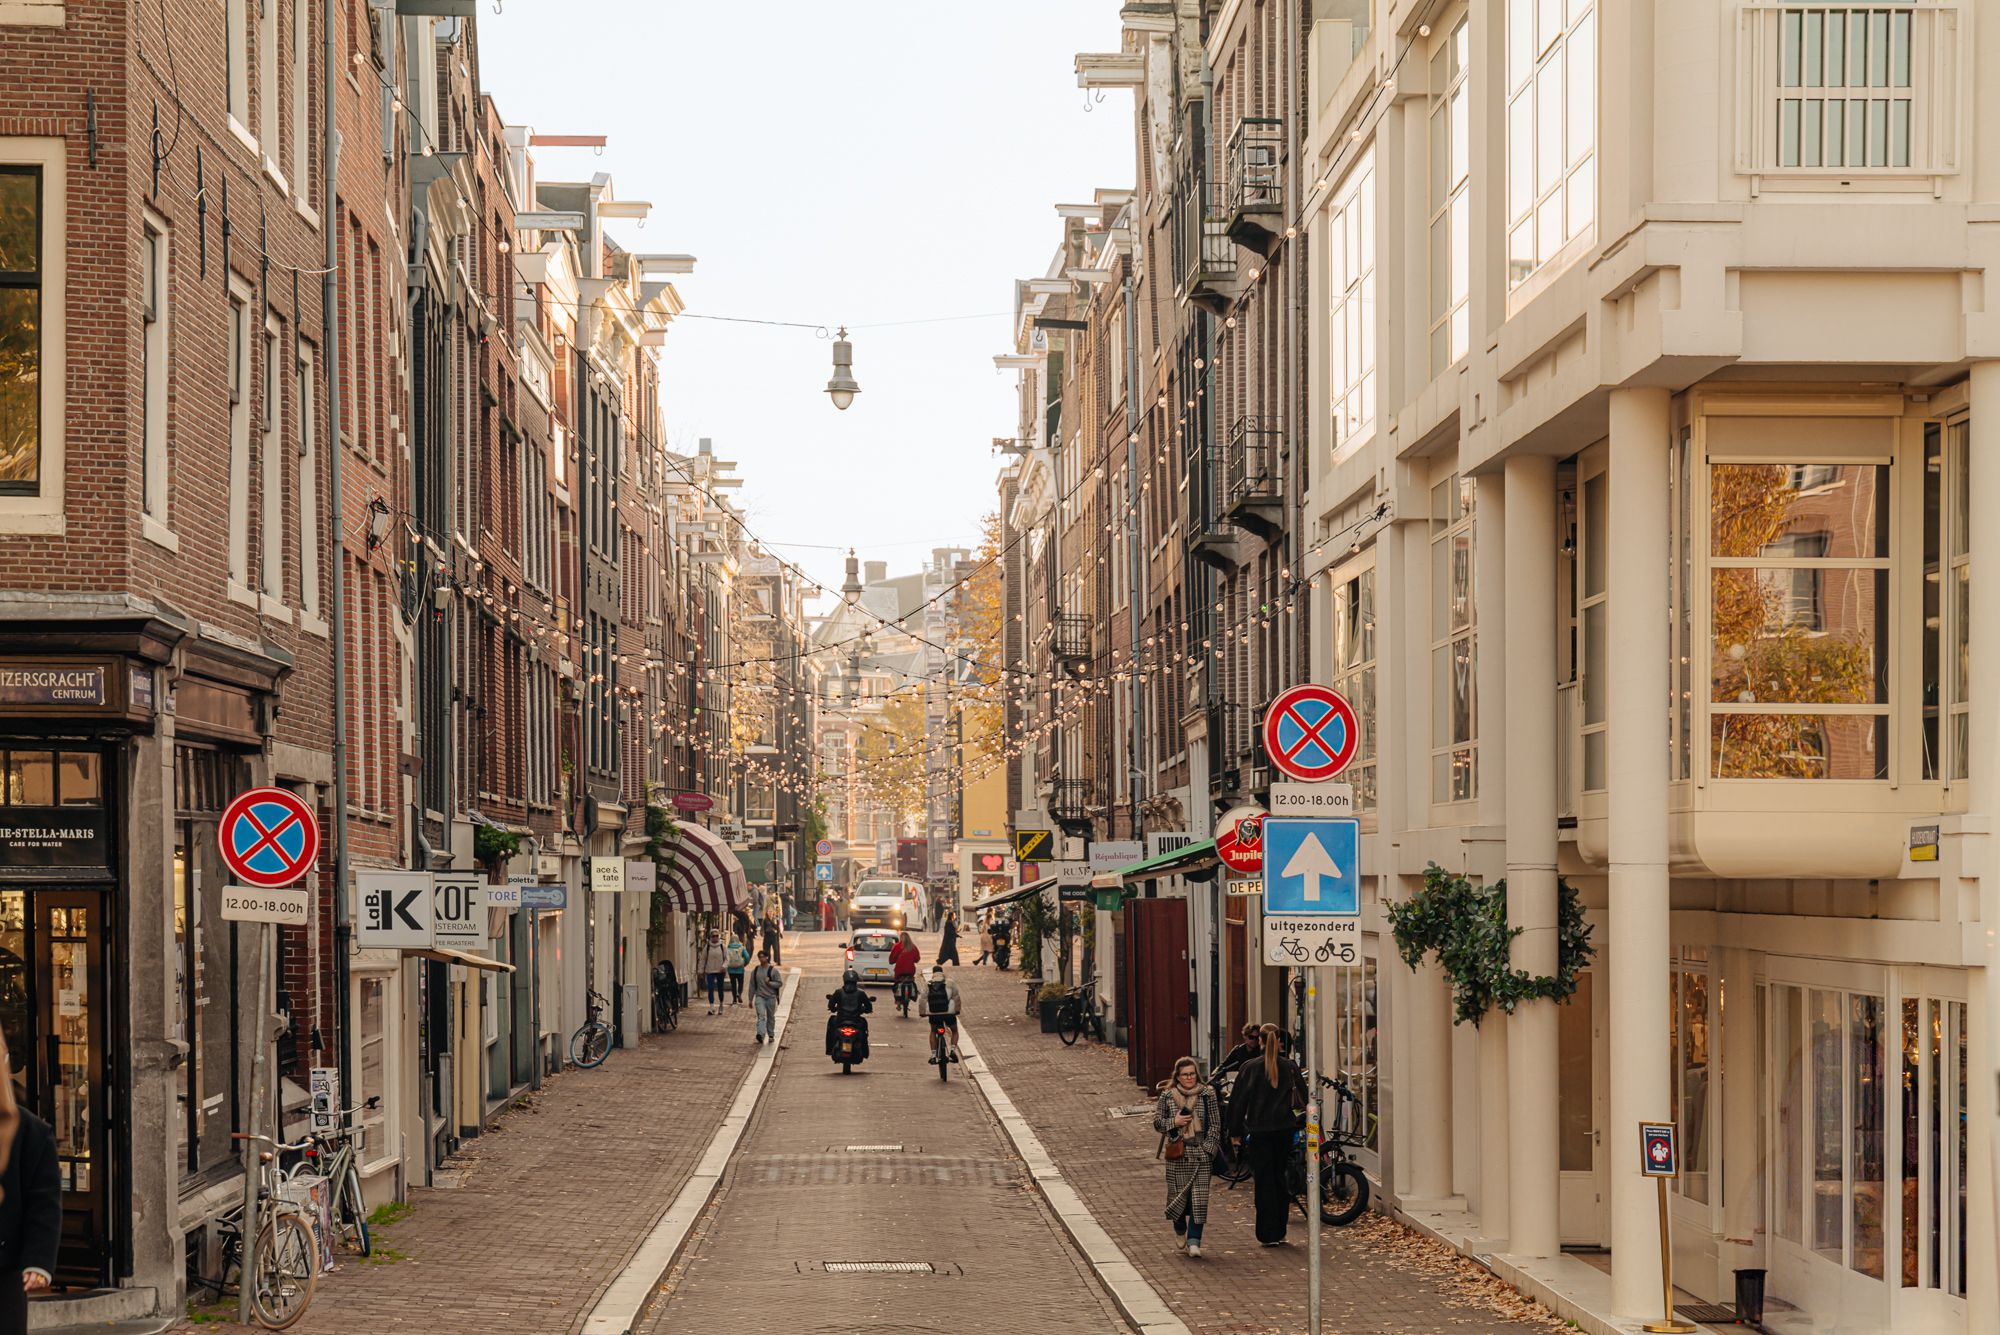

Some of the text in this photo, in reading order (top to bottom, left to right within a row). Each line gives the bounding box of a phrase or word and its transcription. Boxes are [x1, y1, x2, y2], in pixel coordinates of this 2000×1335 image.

[1, 672, 96, 687] IZERSGRACHT
[52, 689, 96, 699] CENTRUM
[1275, 794, 1349, 806] 12.00-18.00h
[0, 828, 95, 839] IE-STELLA-MARIS
[1095, 852, 1138, 861] République
[613, 866, 618, 874] &
[508, 876, 535, 884] polette
[602, 874, 619, 882] tate
[1230, 881, 1262, 894] DE PE
[488, 891, 518, 901] TORE
[226, 898, 303, 914] 12.00-18.00h
[365, 889, 380, 931] LaB.
[381, 889, 425, 931] K
[435, 923, 477, 931] STERDAM
[1270, 920, 1355, 933] uitgezonderd
